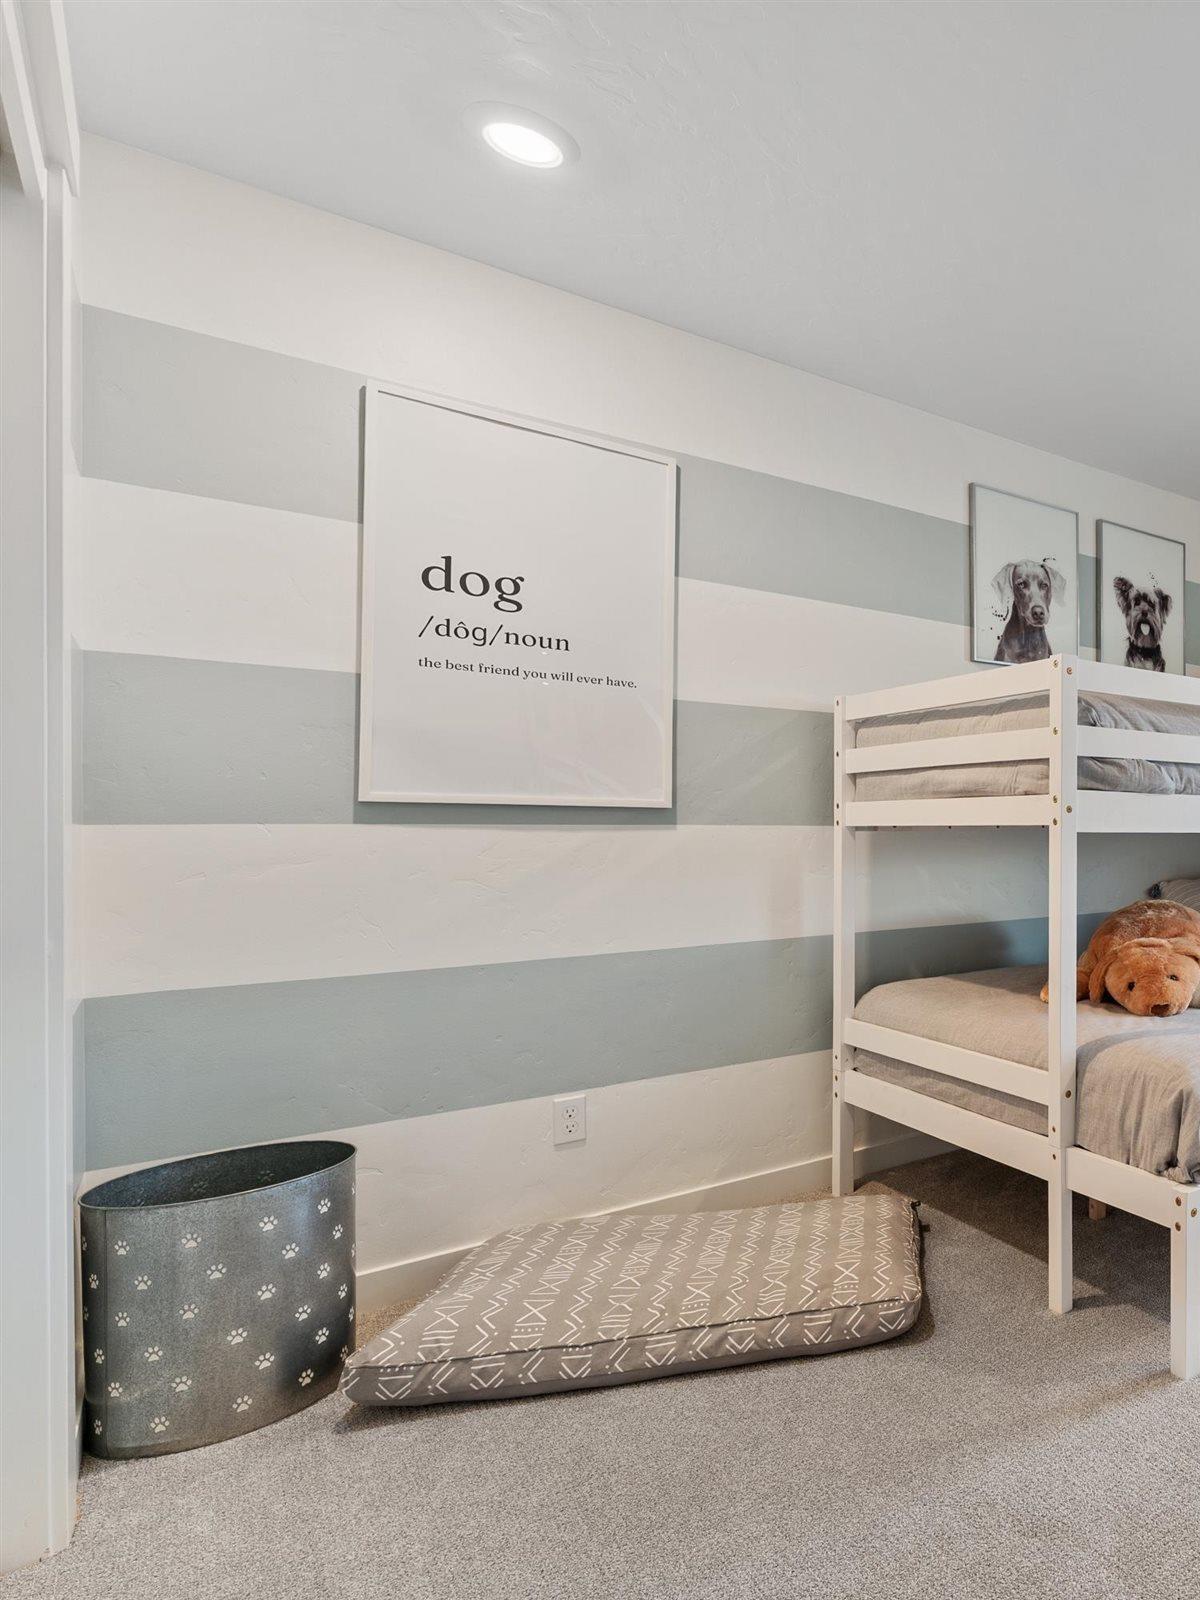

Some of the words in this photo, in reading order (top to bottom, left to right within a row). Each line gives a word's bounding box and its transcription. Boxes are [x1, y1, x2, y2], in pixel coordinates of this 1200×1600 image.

[421, 555, 525, 613] dog
[418, 615, 570, 652] /dôg/noun
[418, 656, 442, 669] the
[445, 659, 475, 673] best
[478, 663, 520, 677] friend
[522, 669, 548, 680] you
[550, 671, 574, 682] will
[576, 676, 604, 685] ever
[606, 676, 638, 689] have.
